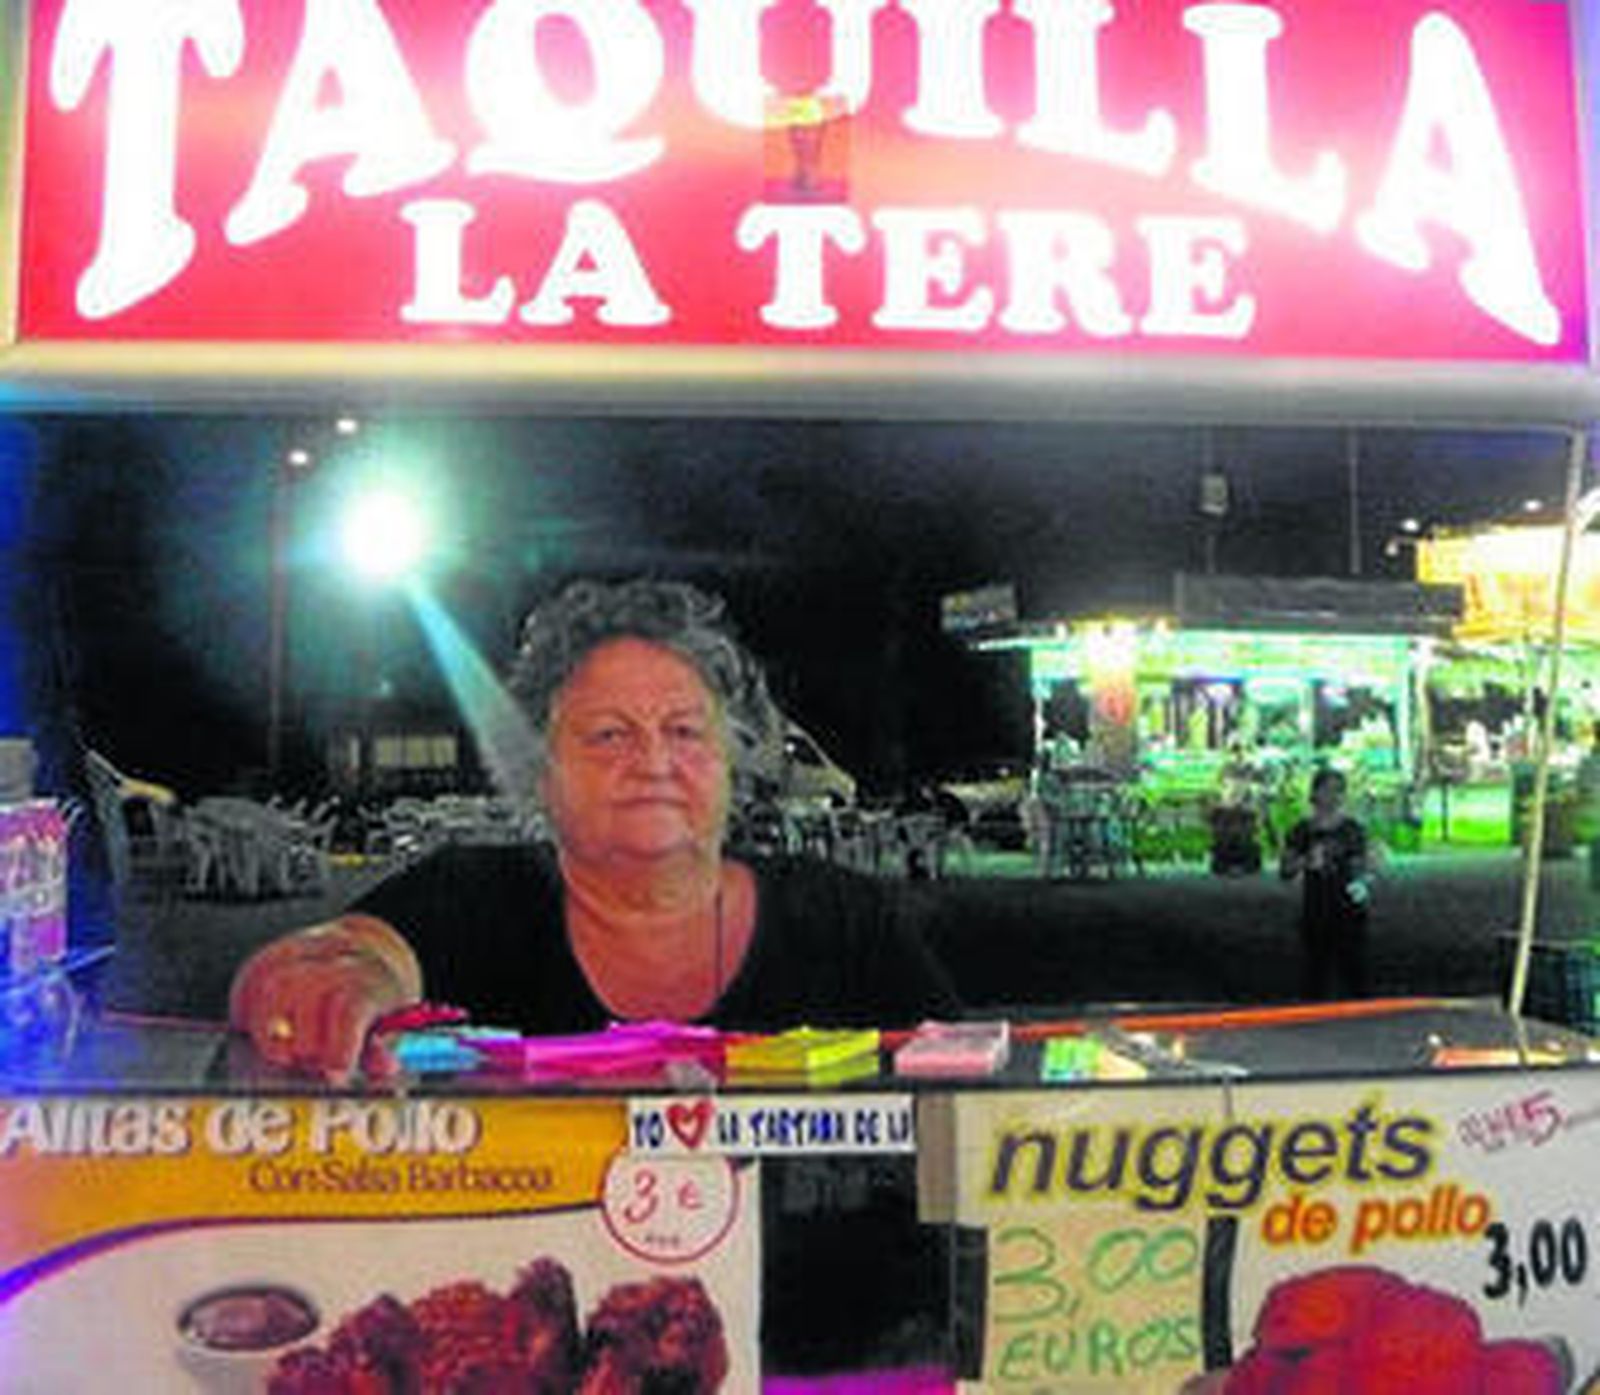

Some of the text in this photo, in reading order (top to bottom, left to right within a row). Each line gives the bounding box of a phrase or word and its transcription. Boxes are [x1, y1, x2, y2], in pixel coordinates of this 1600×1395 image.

[50, 0, 1560, 343] TAQUILLA
[399, 200, 1256, 337] LA TERE
[205, 1098, 296, 1155] de
[311, 1098, 481, 1154] Pollo
[633, 1110, 665, 1147] YO
[990, 1102, 1435, 1212] nuggets
[317, 1159, 399, 1193] Salsa
[407, 1161, 552, 1192] Barbacoa
[624, 1168, 657, 1224] 3
[1261, 1184, 1490, 1255] de pollo
[993, 1226, 1200, 1323] 3,00
[1483, 1218, 1588, 1307] 3,00
[997, 1316, 1200, 1382] EUROS
